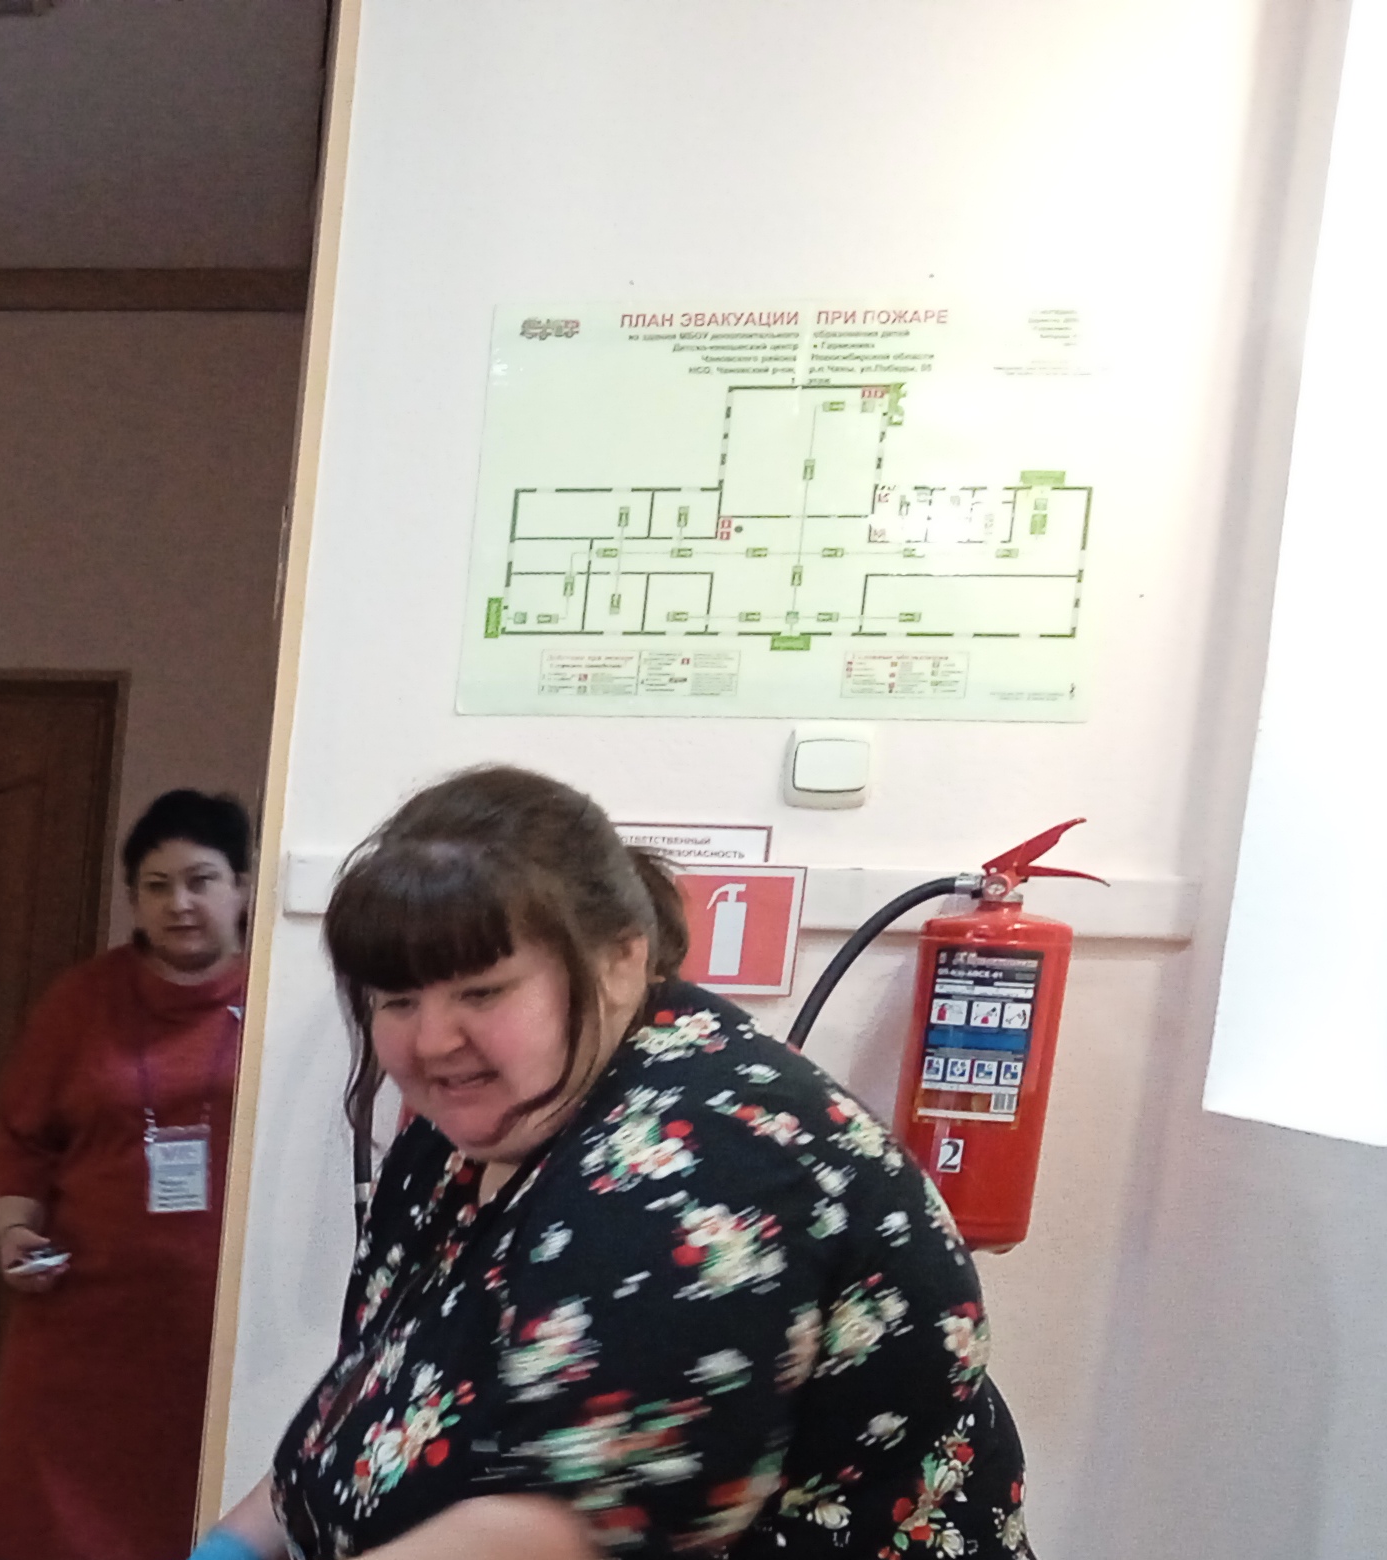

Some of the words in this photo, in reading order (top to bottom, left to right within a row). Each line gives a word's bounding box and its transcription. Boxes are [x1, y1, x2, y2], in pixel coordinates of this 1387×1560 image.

[620, 313, 674, 328] ПЛАН
[680, 311, 799, 327] ЭВАКУАЦИИ
[816, 310, 857, 325] ПРИ
[862, 309, 949, 325] ПОЖАРЕ
[621, 836, 712, 846] ОТВЕТСТВЕННЫЙ
[939, 1140, 961, 1170] 2
